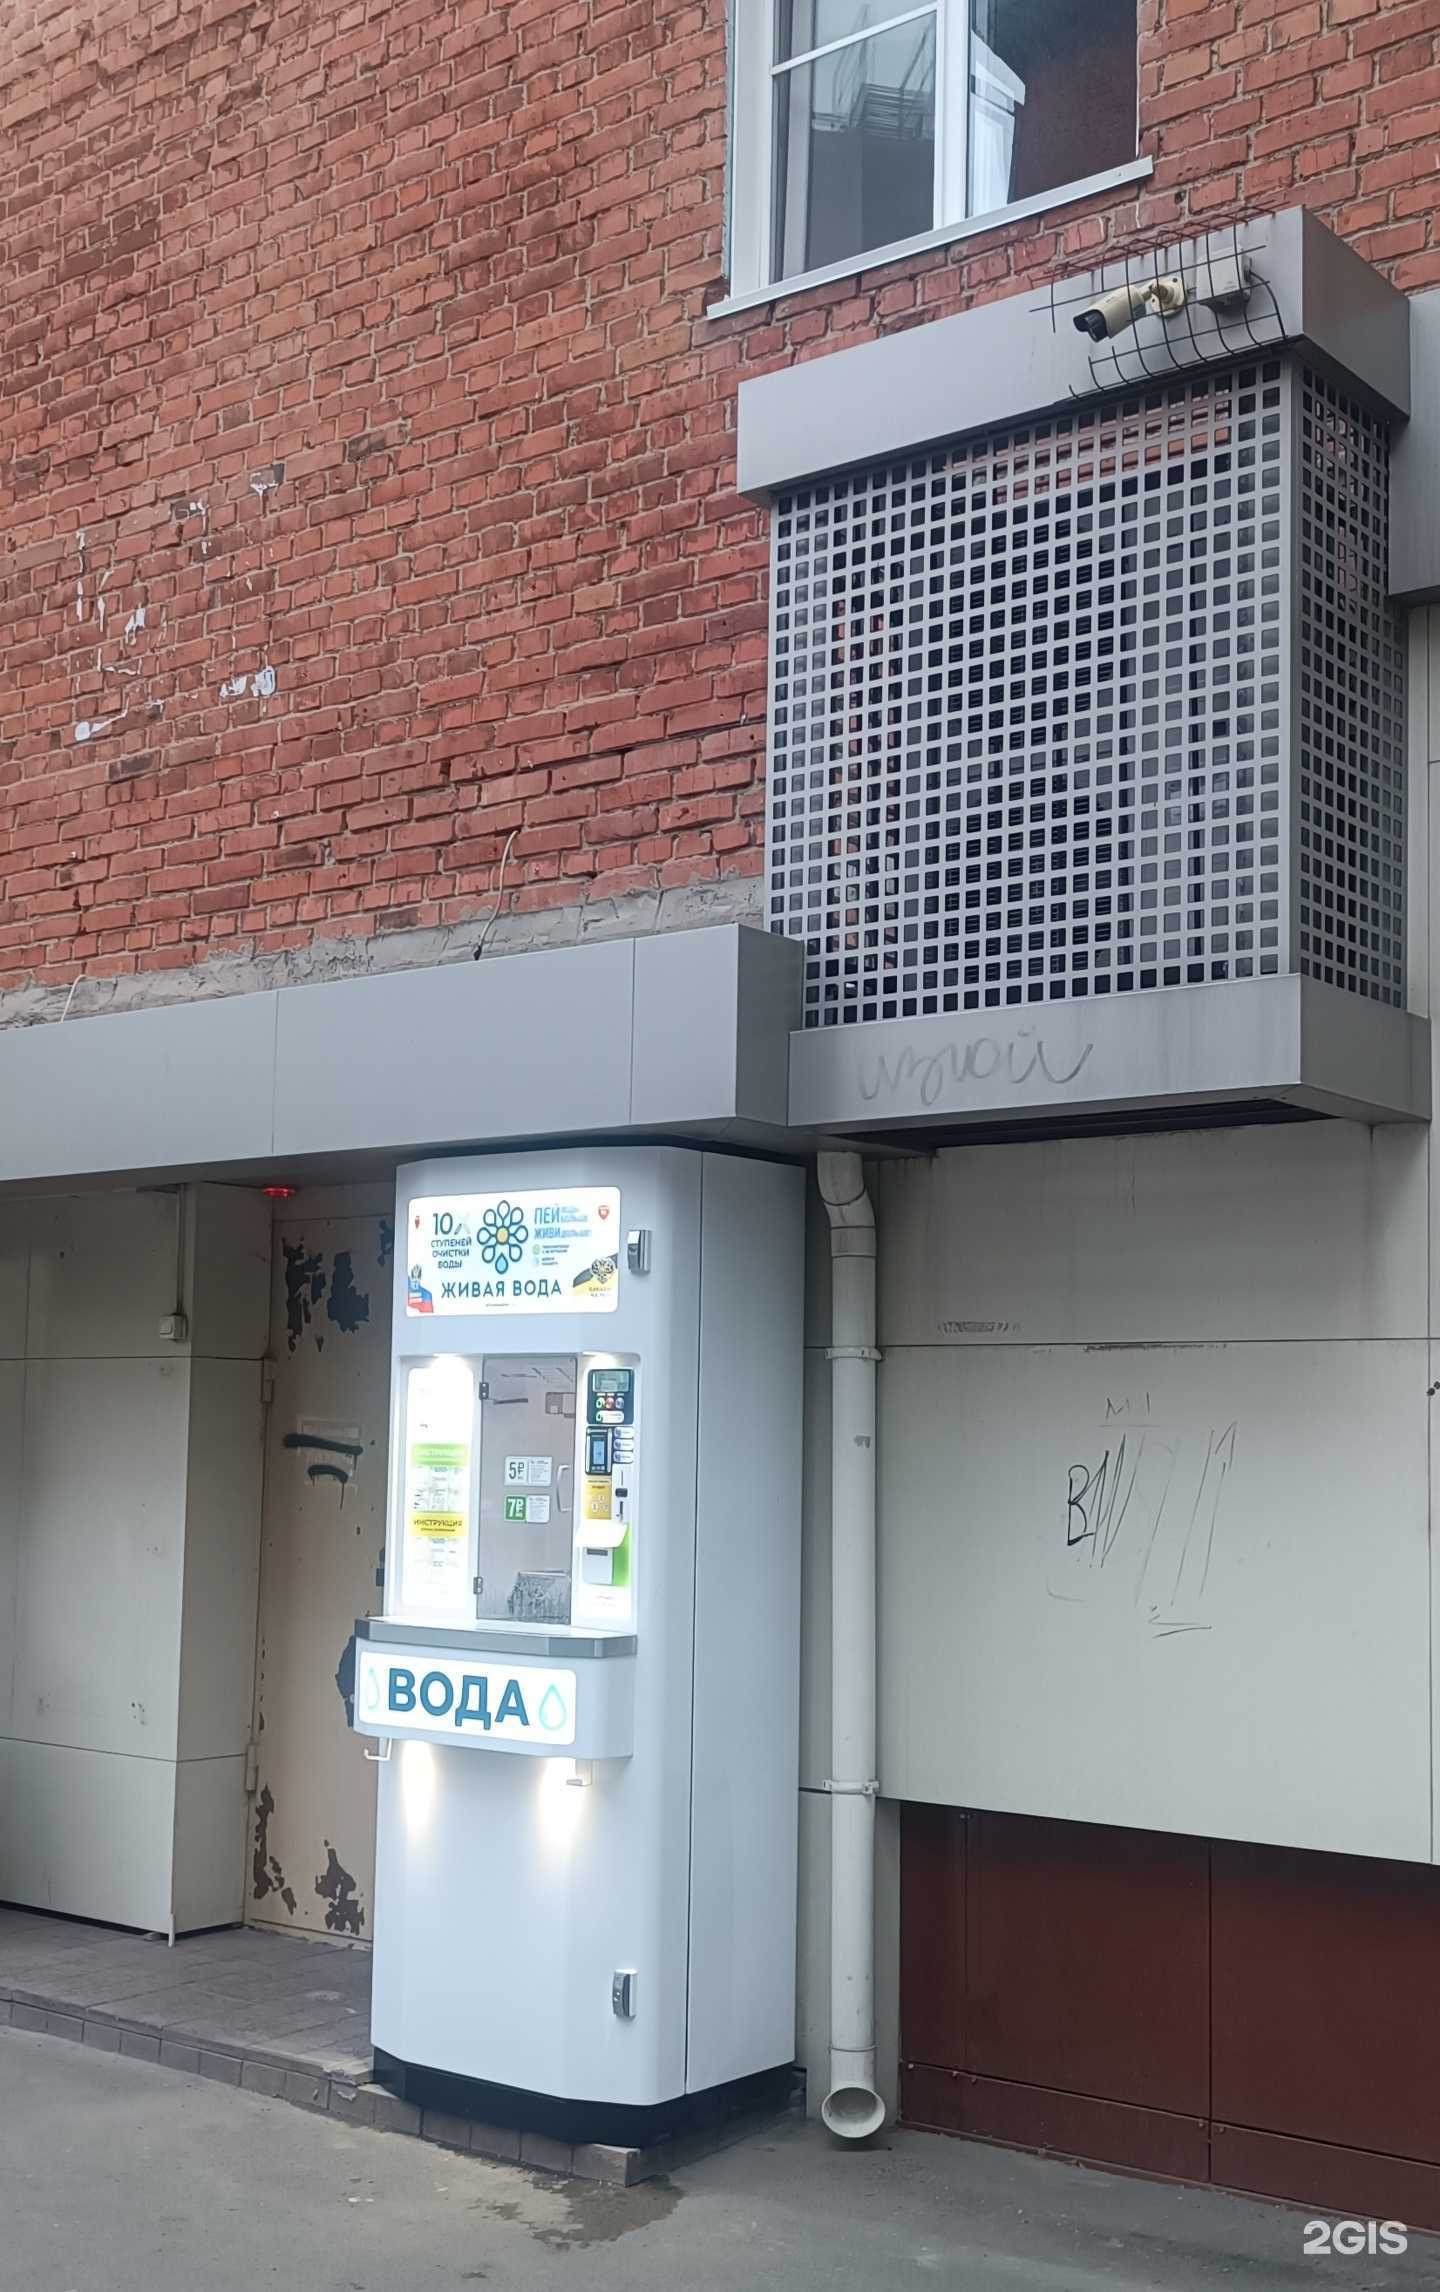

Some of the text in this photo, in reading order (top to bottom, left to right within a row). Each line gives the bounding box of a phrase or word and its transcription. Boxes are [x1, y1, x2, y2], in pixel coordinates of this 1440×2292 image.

[534, 1203, 560, 1224] ПЕЙ
[431, 1237, 472, 1248] СТУПЕНЕЙ
[432, 1249, 470, 1258] ОЧИСТКИ
[437, 1260, 463, 1270] ВОДЫ
[441, 1278, 562, 1299] ЖИВАЯ ВОДА
[388, 1667, 530, 1731] ВОДА
